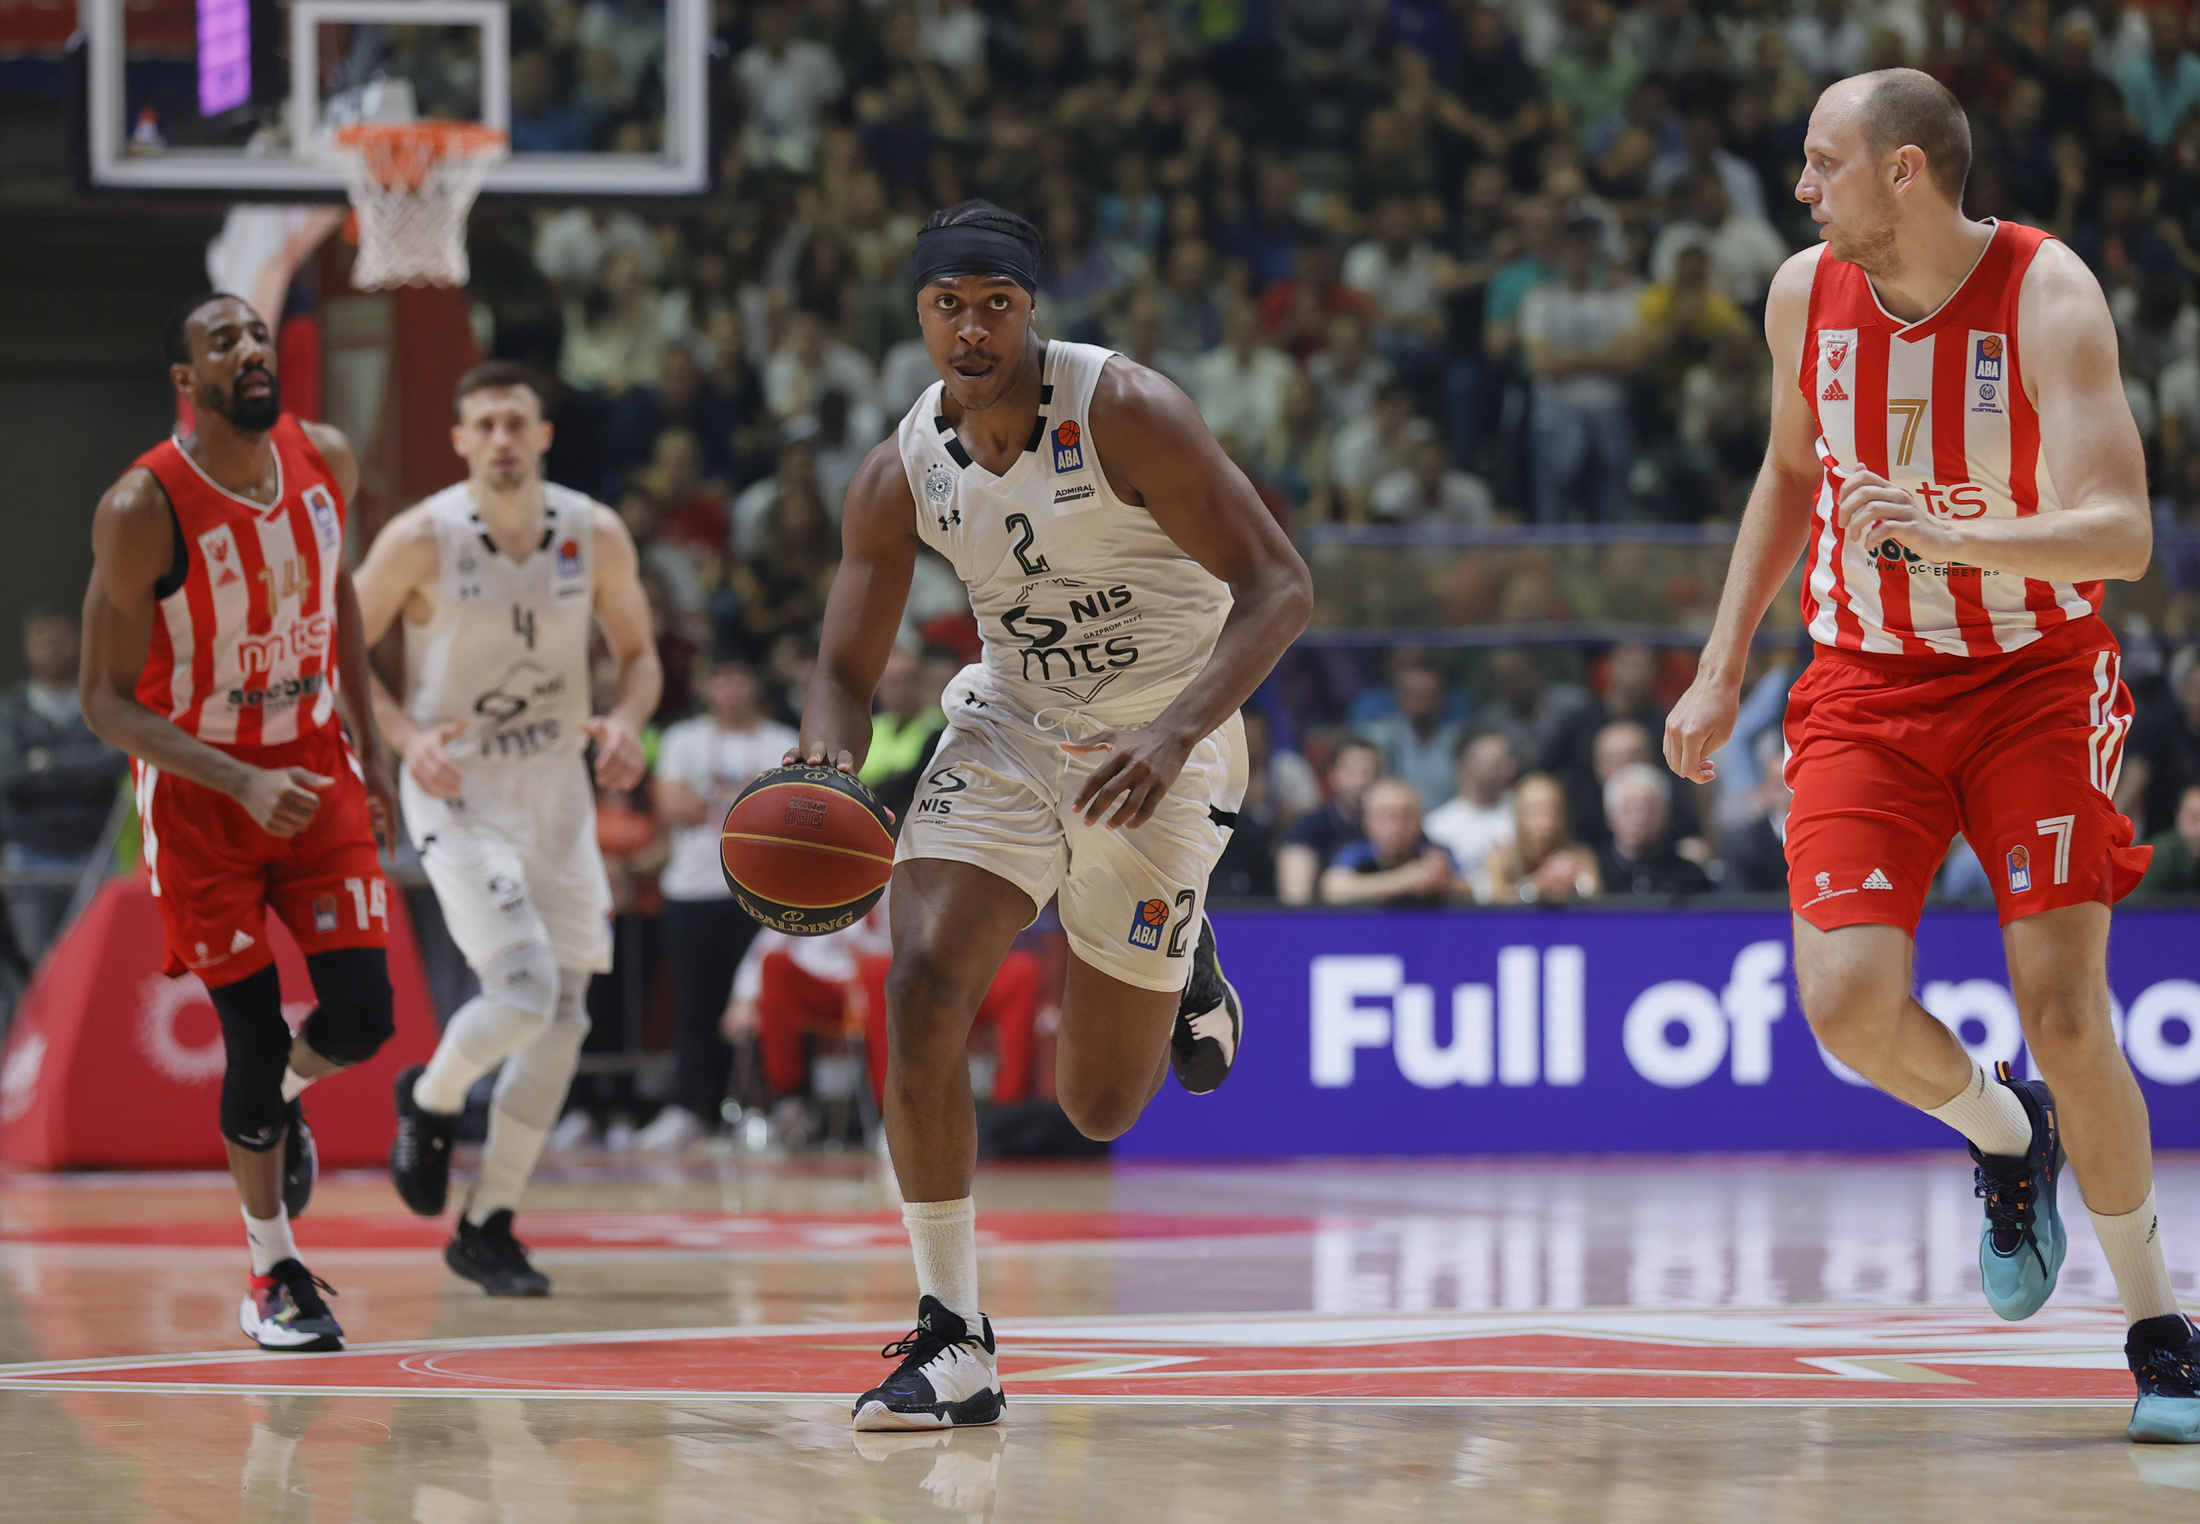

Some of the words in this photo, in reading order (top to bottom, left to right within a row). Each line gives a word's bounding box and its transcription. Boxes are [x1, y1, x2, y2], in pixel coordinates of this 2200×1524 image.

[1976, 360, 1999, 378] ABA
[1889, 399, 1929, 467] 7
[1056, 448, 1081, 470] ABA
[1055, 483, 1096, 498] ADMIRAL
[1081, 490, 1096, 499] BET
[1900, 481, 1988, 520] ts
[1005, 512, 1051, 576] 2
[258, 553, 310, 617] 14
[1069, 584, 1132, 624] NIS
[513, 604, 534, 650] 4
[1083, 622, 1122, 640] GAZPROM
[1123, 613, 1143, 626] NEFT
[1018, 635, 1139, 681] mts
[785, 808, 825, 830] FIBA
[788, 801, 826, 812] APPROVED
[917, 798, 953, 815] NIS
[2036, 814, 2076, 885] 7
[1861, 882, 1893, 891] adidas
[2012, 869, 2028, 890] ABA
[344, 876, 390, 933] 14
[736, 893, 855, 934] SPALDING
[1166, 889, 1196, 958] 2
[1131, 923, 1158, 947] ABA
[1309, 944, 1587, 1090] Full
[1622, 939, 1787, 1090] of
